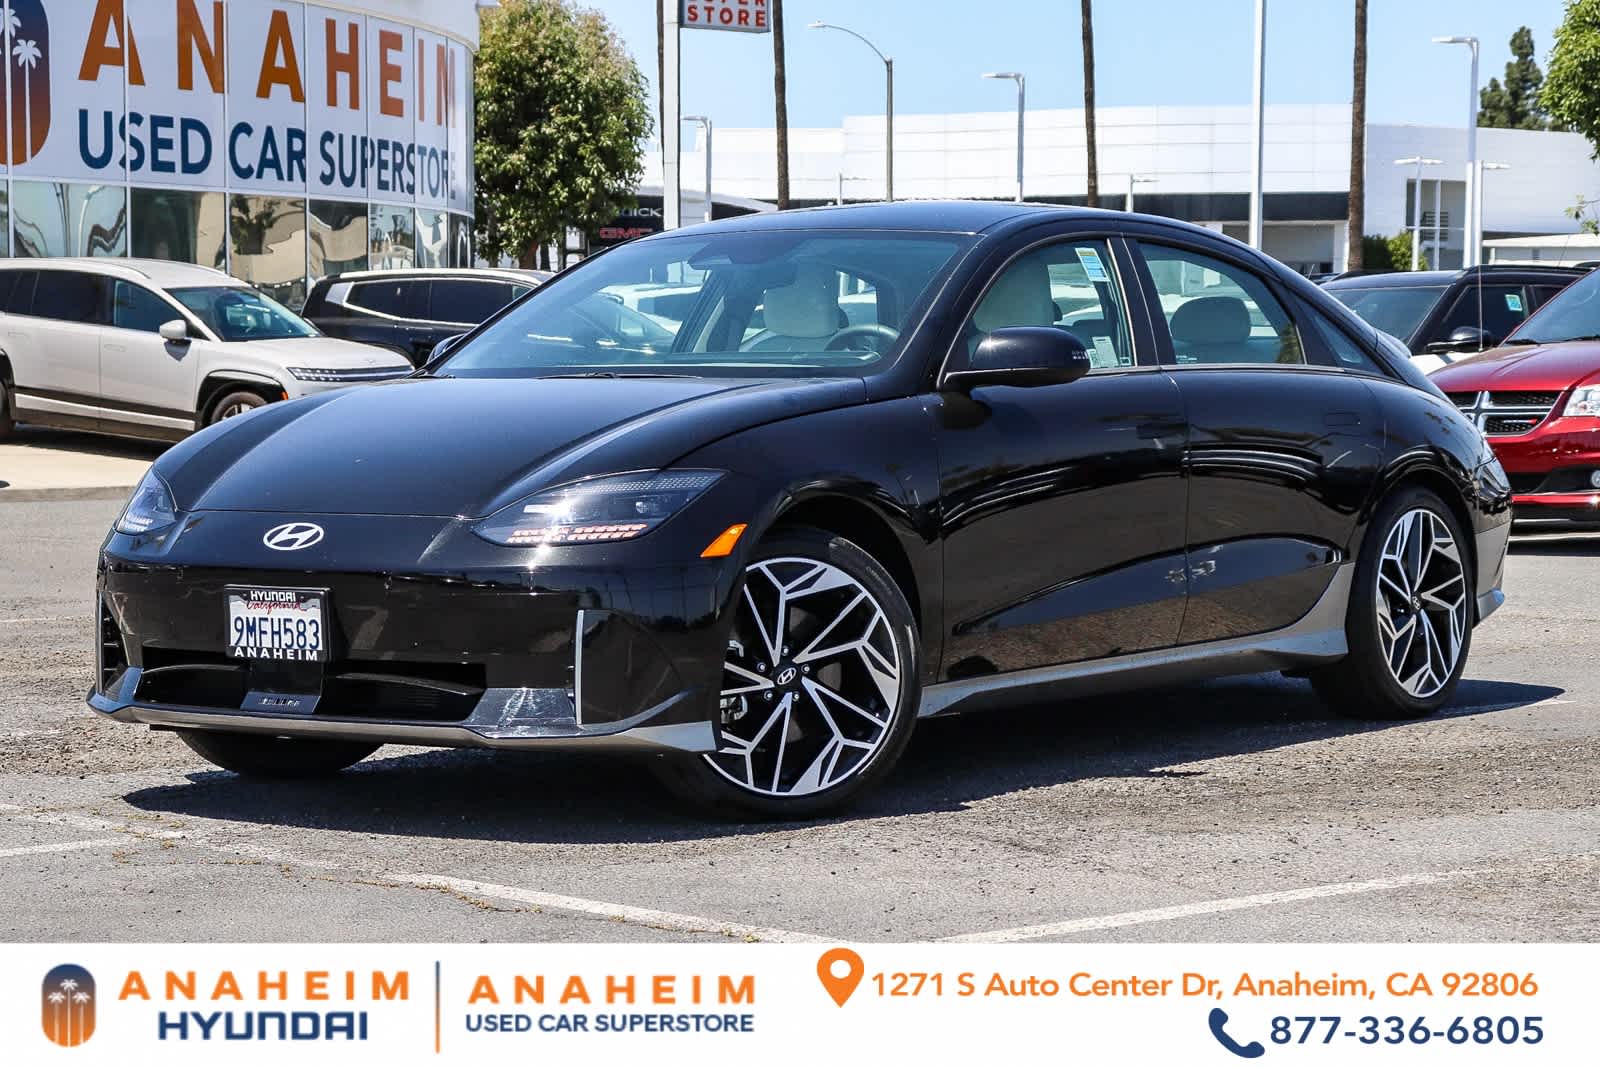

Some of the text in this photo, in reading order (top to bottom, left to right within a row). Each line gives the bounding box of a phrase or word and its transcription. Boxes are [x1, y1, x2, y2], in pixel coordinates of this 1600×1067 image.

[687, 5, 766, 26] STORE
[78, 0, 456, 128] ANAHEIM
[79, 109, 456, 200] USED CAR SUPERSTORE
[621, 207, 662, 217] UICK
[250, 590, 296, 601] HYUNDAI
[234, 616, 320, 650] 9MFH583
[234, 646, 318, 661] ANAHEIM
